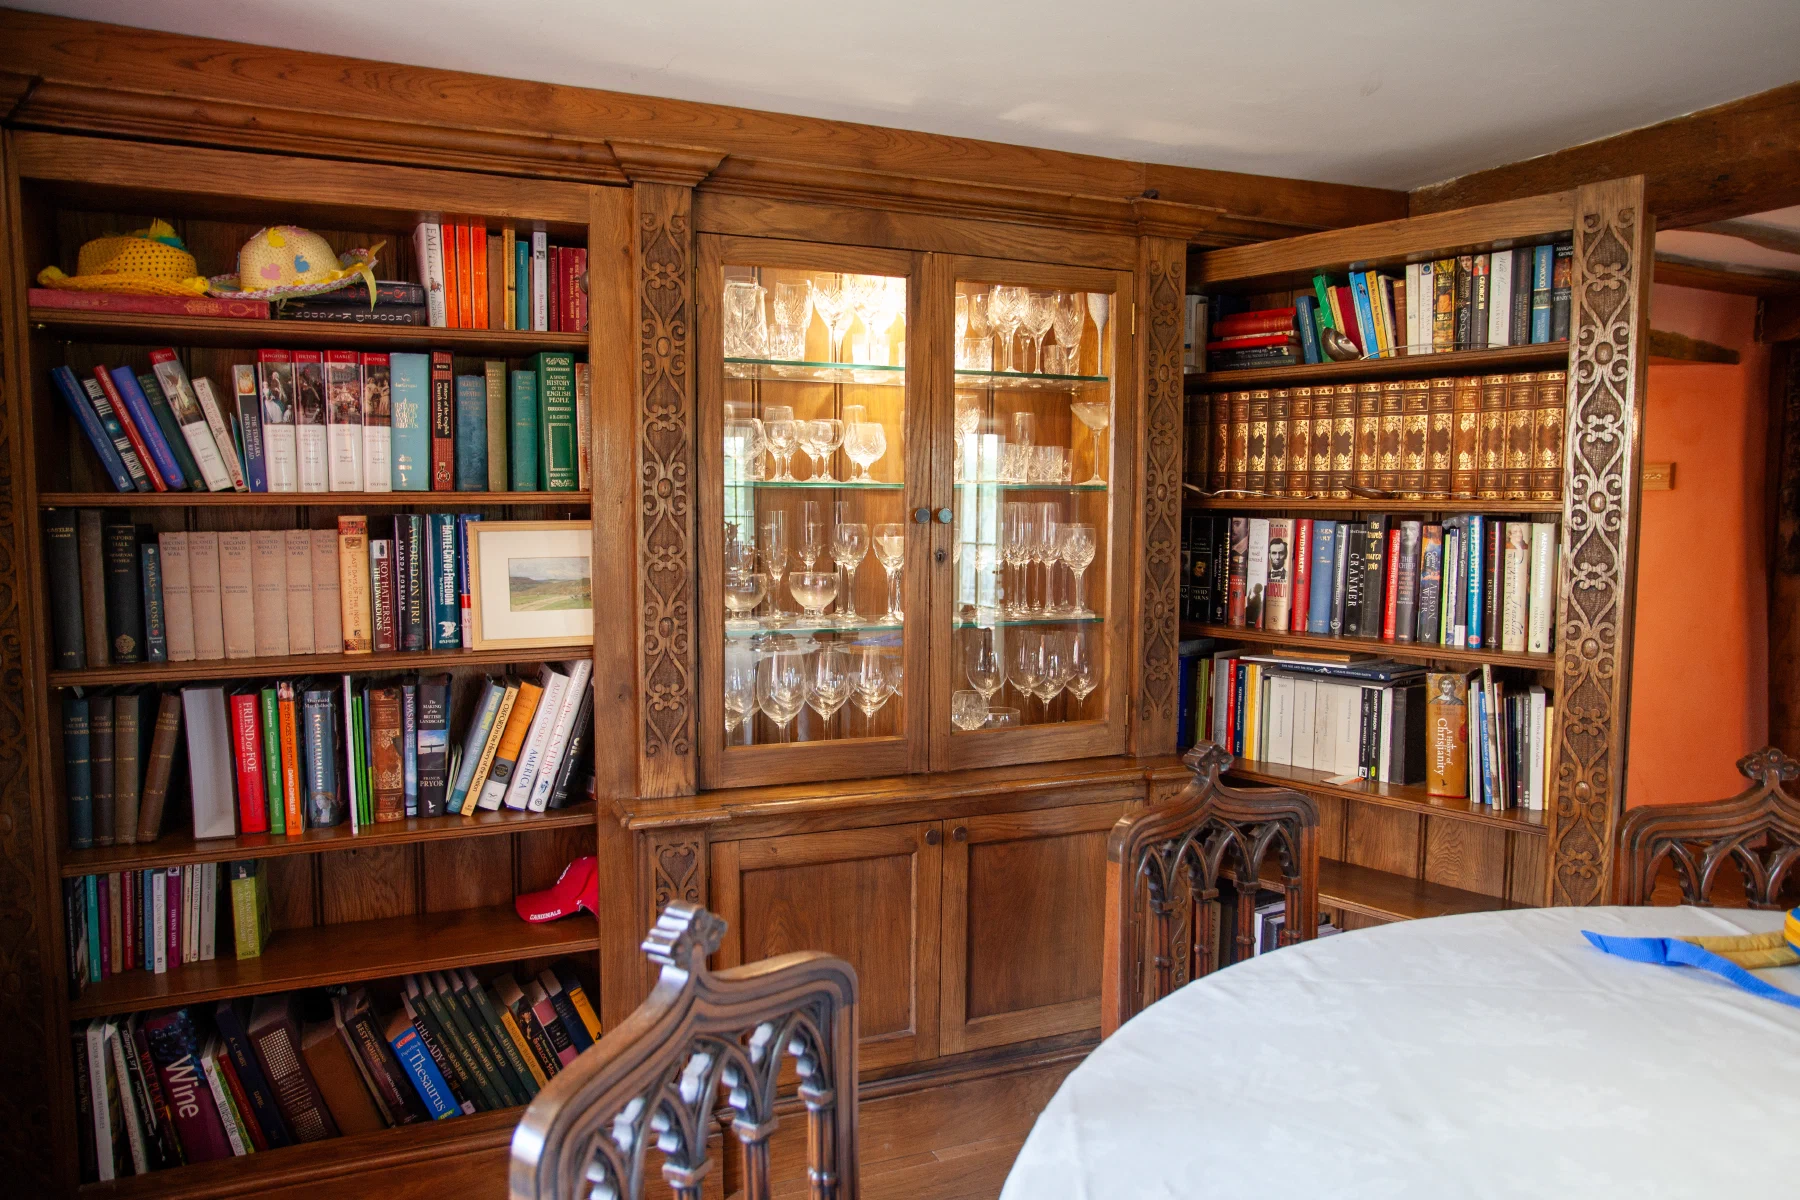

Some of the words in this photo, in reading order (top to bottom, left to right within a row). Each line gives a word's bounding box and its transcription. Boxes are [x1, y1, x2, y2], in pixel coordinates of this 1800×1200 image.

[1477, 275, 1486, 302] GEORGE
[295, 311, 351, 319] KINGDOM
[354, 311, 412, 323] CROOKED
[429, 292, 438, 326] FERGUSON
[1493, 300, 1501, 336] DALRYMPLE
[435, 381, 444, 402] Church
[243, 412, 251, 428] PIERS
[434, 411, 443, 430] People
[442, 416, 450, 435] English
[92, 395, 111, 417] INTEL
[121, 447, 147, 480] JACKSON
[251, 428, 261, 457] TEMPLARS
[408, 525, 417, 533] A
[440, 523, 455, 549] BATTLE
[1298, 524, 1306, 545] DAVID
[1367, 531, 1382, 539] travels
[1370, 521, 1379, 529] the
[442, 548, 457, 563] CRY
[1221, 531, 1230, 557] LORD
[1460, 539, 1468, 559] William
[350, 553, 358, 567] LAST
[407, 535, 419, 577] WORLD
[442, 562, 453, 573] OF
[1296, 544, 1305, 574] STARKEY
[1365, 553, 1382, 561] marco
[1367, 562, 1379, 571] polo
[1398, 562, 1416, 570] CHIEF
[147, 561, 156, 587] WARS
[350, 568, 359, 585] DAYS
[372, 567, 381, 580] THE
[379, 560, 389, 581] ROY
[1220, 557, 1230, 604] HAILSHAM
[1346, 552, 1360, 607] CRANMER
[1357, 557, 1365, 604] THOMAS
[1504, 552, 1512, 587] WALTER
[352, 586, 359, 595] OF
[409, 578, 419, 596] ON
[442, 572, 457, 605] FREEDOM
[352, 595, 360, 607] THE
[372, 582, 384, 631] EDWARDIANS
[378, 580, 394, 638] HATTERSLEY
[1419, 586, 1430, 613] WEIR
[1425, 582, 1439, 620] ALISON
[149, 600, 159, 629] ROSES
[352, 608, 360, 627] INCAS
[409, 599, 420, 625] FIRE
[1503, 590, 1511, 636] ISAACSON
[242, 701, 255, 741] FRIEND
[266, 709, 274, 727] Berners
[283, 703, 291, 723] SEVEN
[405, 692, 414, 732] INVASION
[495, 702, 509, 730] OXFORD
[245, 740, 254, 751] or
[267, 731, 276, 754] Composer
[285, 737, 292, 745] OF
[490, 733, 498, 743] the
[539, 723, 567, 776] CENTURY
[1433, 717, 1449, 777] Christianity
[245, 751, 257, 773] FOE
[285, 746, 293, 769] BRITAIN
[311, 713, 326, 790] Reformation
[483, 741, 495, 761] History
[1446, 758, 1454, 766] of
[478, 765, 486, 775] the
[481, 759, 488, 767] of
[518, 748, 539, 790] AMERICA
[286, 768, 294, 787] DAVID
[472, 773, 483, 793] Nation
[272, 796, 281, 817] Dickinson
[287, 786, 296, 815] DIMBLEBY
[529, 908, 562, 921] CARDINALS
[355, 1023, 368, 1040] BEST
[413, 1019, 430, 1039] THE
[424, 1035, 443, 1065] LADY
[448, 1051, 468, 1082] SEASHORE
[481, 1055, 494, 1073] WILD
[490, 1044, 506, 1068] WORLD
[501, 1037, 526, 1074] RIVERBANK
[461, 1049, 488, 1087] WOODLANDS
[93, 1069, 102, 1099] MISSOURI
[165, 1053, 200, 1119] Wine
[407, 1049, 446, 1113] Thesaurus
[96, 1100, 105, 1129] WINERIES
